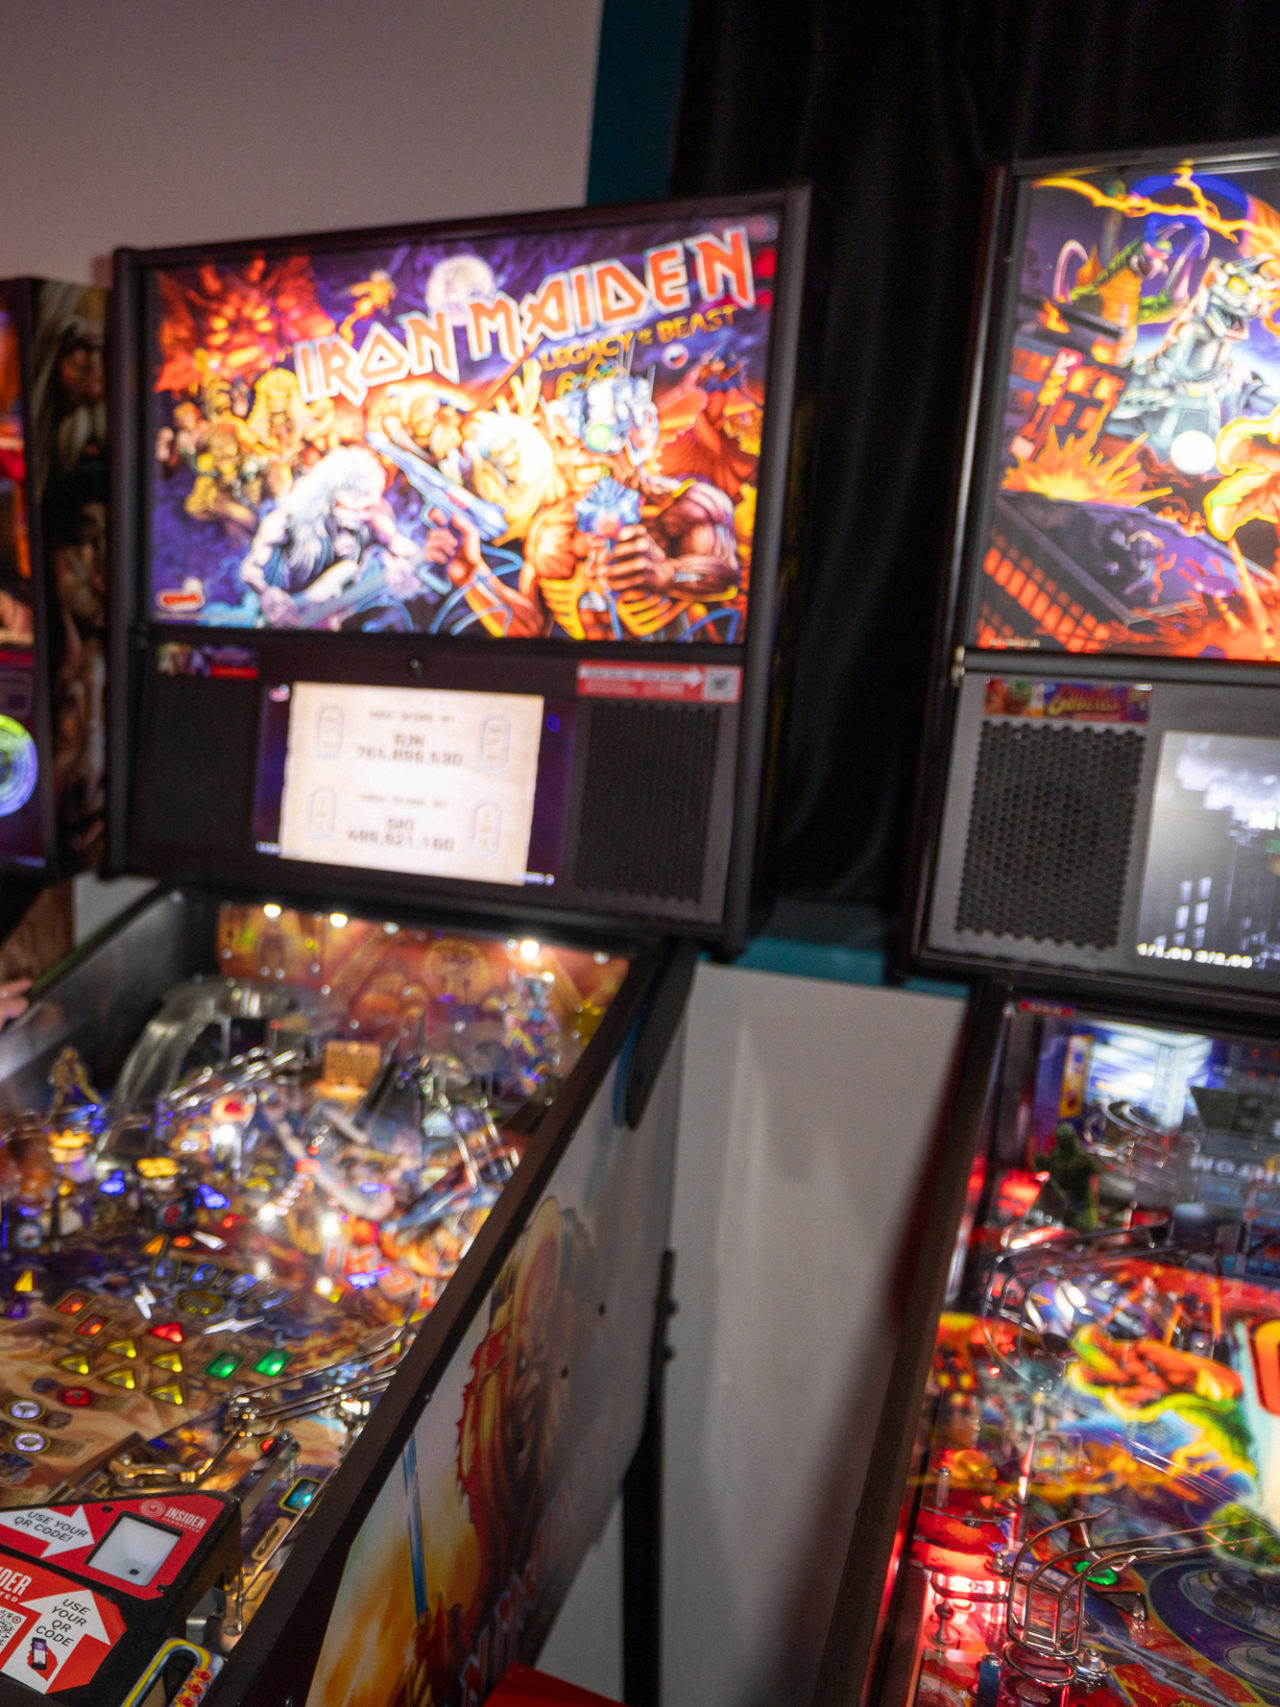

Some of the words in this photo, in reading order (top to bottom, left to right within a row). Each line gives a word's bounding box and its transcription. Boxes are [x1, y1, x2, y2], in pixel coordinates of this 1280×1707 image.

[294, 311, 460, 407] IRON
[467, 226, 756, 364] MAIDEN
[538, 331, 634, 371] LEGACY
[656, 304, 738, 343] BEAST
[14, 1516, 33, 1527] QR
[34, 1524, 73, 1542] CODE!
[27, 1511, 54, 1524] USE
[54, 1521, 88, 1537] YOUR
[165, 1506, 207, 1529] INSIDER
[51, 1605, 87, 1627] YOUR
[62, 1598, 91, 1615] USE
[35, 1625, 74, 1647] CODE
[51, 1619, 72, 1632] QR
